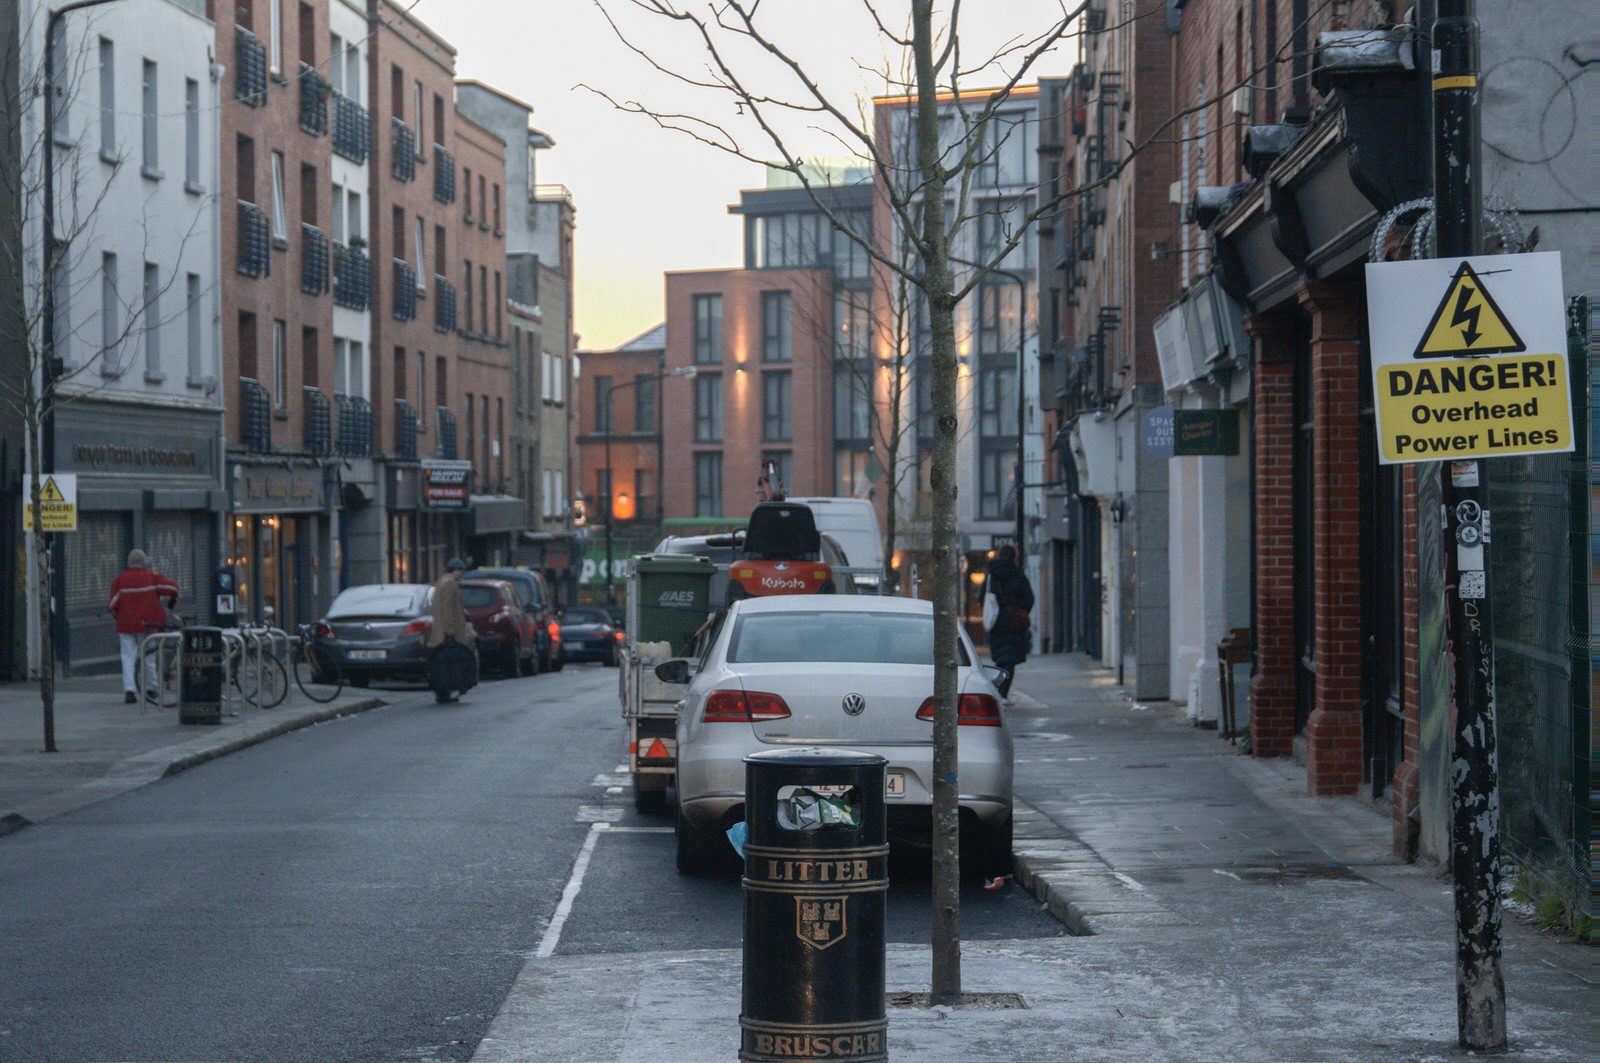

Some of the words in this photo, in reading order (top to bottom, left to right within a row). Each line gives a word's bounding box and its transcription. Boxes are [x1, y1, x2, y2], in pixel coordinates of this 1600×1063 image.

[1388, 359, 1557, 397] DANGER!
[1411, 396, 1538, 424] Overhead
[1395, 433, 1479, 454] Power
[1487, 424, 1559, 449] Lines
[27, 503, 72, 512] DNGER!
[761, 576, 805, 590] Kubota
[669, 590, 695, 602] AES
[768, 859, 869, 881] LITTER
[754, 1033, 881, 1058] BRUSCAR
